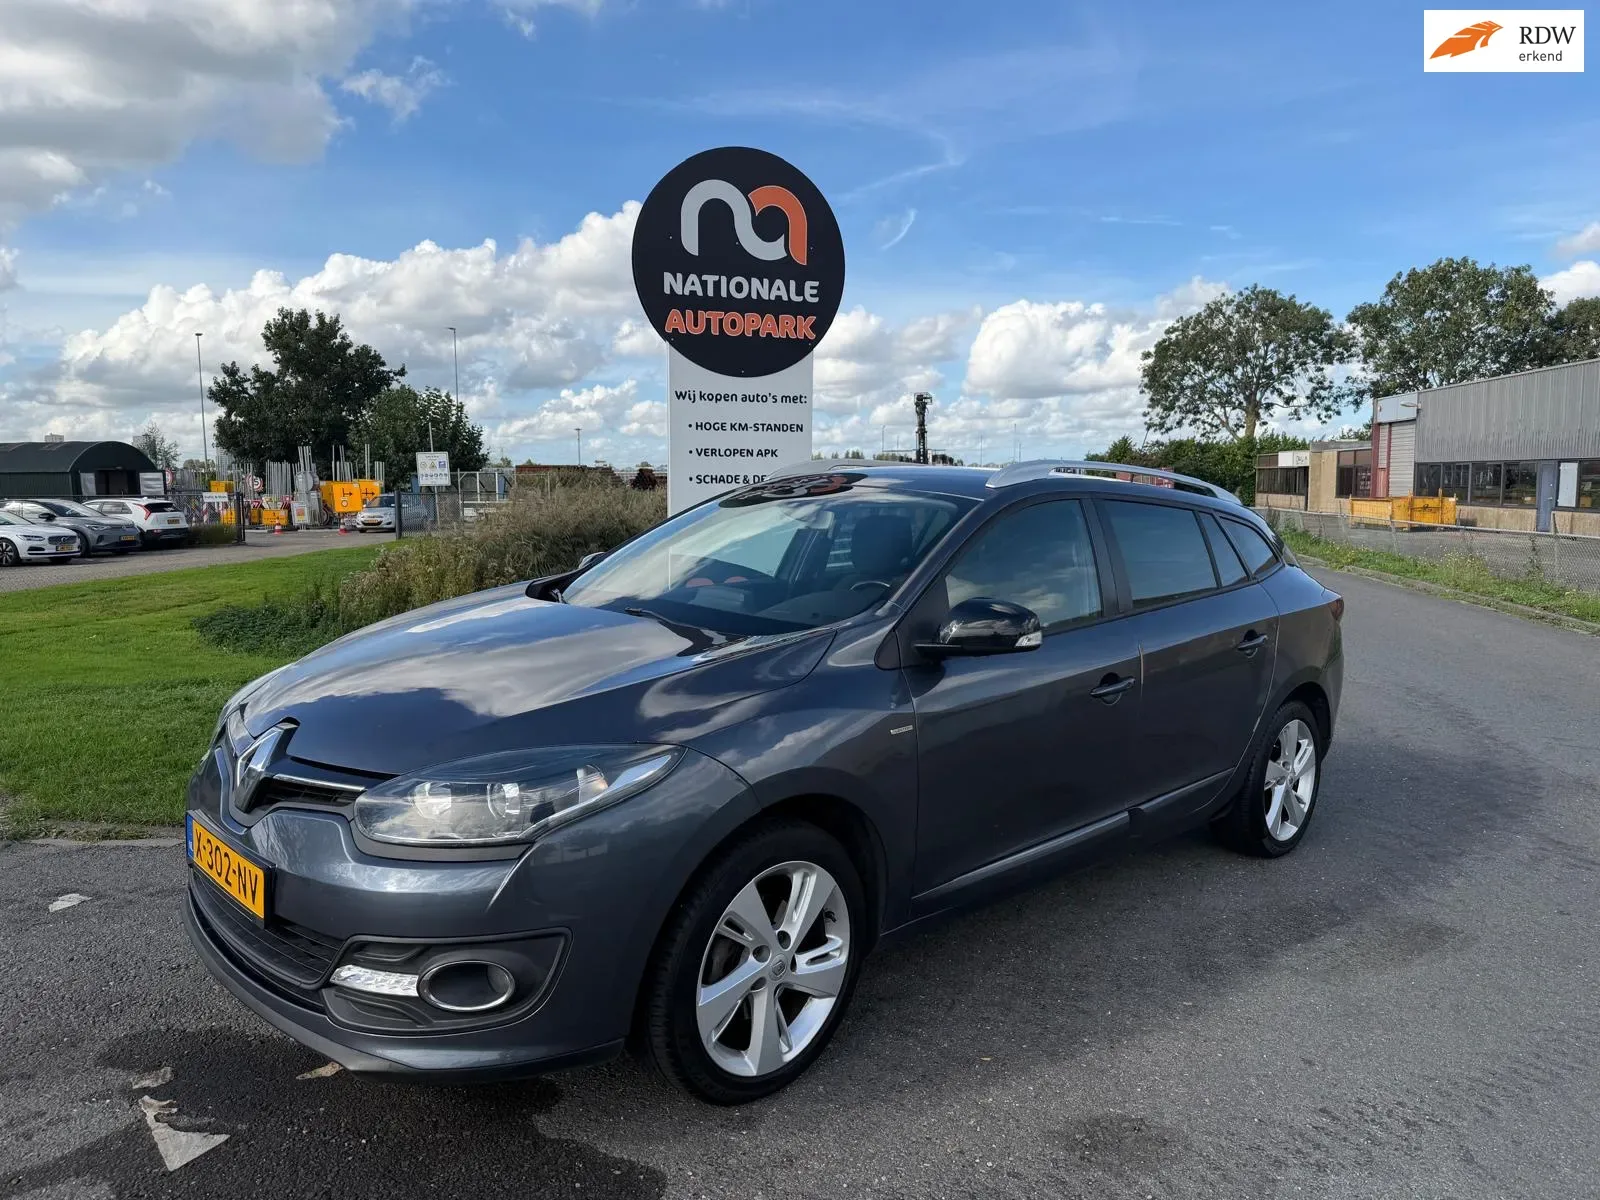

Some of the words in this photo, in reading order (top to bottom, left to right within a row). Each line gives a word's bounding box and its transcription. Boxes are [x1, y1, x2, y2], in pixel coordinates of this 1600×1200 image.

[663, 272, 820, 303] NATIONALE
[665, 309, 817, 340] AUTOPARK
[674, 390, 696, 403] Wij
[699, 390, 738, 403] kopen
[741, 393, 778, 404] auto's
[780, 394, 808, 404] met:
[695, 421, 727, 432] HOGE
[730, 422, 804, 433] KM-STANDEN
[695, 447, 754, 458] VERLOPEN
[756, 448, 779, 458] APK
[695, 474, 740, 485] SCHADE
[742, 475, 750, 484] &
[194, 828, 258, 906] X-302-NV
